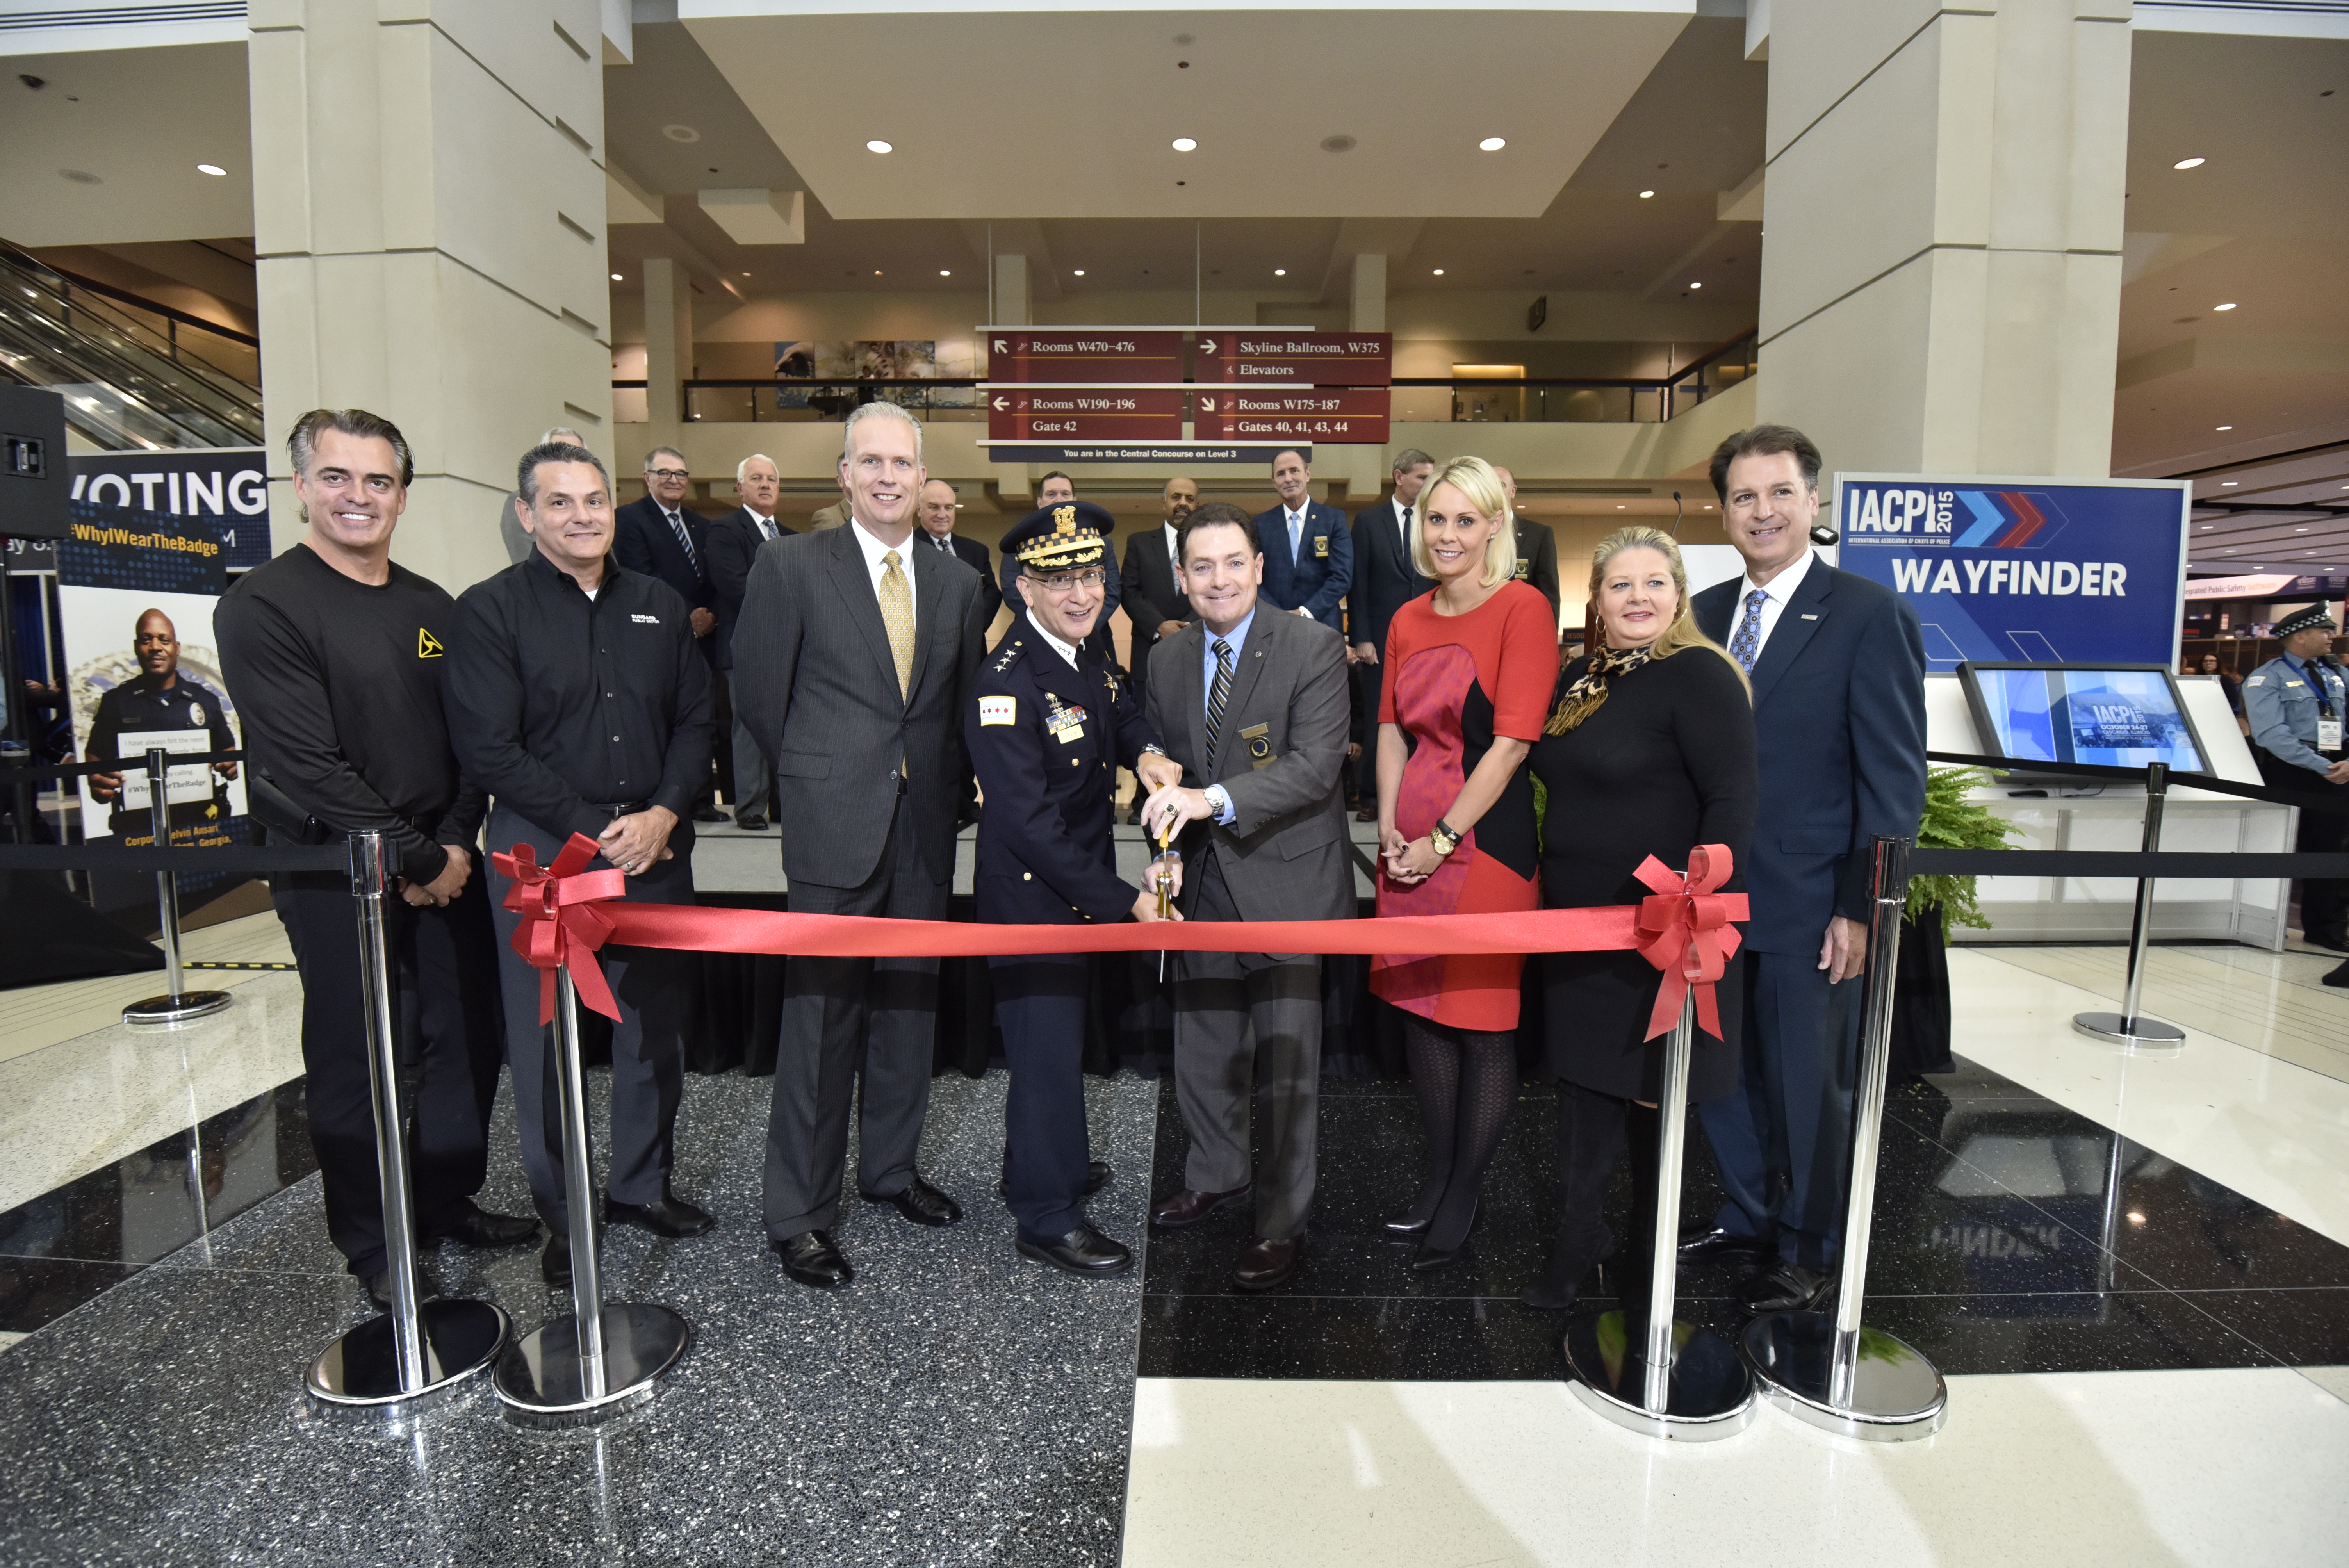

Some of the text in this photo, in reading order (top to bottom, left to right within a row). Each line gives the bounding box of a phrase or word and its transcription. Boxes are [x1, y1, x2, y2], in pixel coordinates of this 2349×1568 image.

[1032, 341, 1073, 352] Rooms
[1240, 342, 1380, 355] Skyline Ballroom, W375
[1240, 364, 1294, 375] Elevators
[1032, 399, 1074, 409] Rooms
[1238, 399, 1280, 410] Rooms
[1032, 421, 1077, 431] Gate 42
[1238, 421, 1348, 433] Gates 40, 41, 43, 44
[1936, 490, 1953, 533] 2015
[1891, 558, 2128, 597] WAYFINDER
[2186, 587, 2207, 596] egrated
[2227, 584, 2246, 593] Safety
[2133, 706, 2146, 724] 2015
[170, 828, 191, 839] elvin
[193, 823, 218, 835] Ansari
